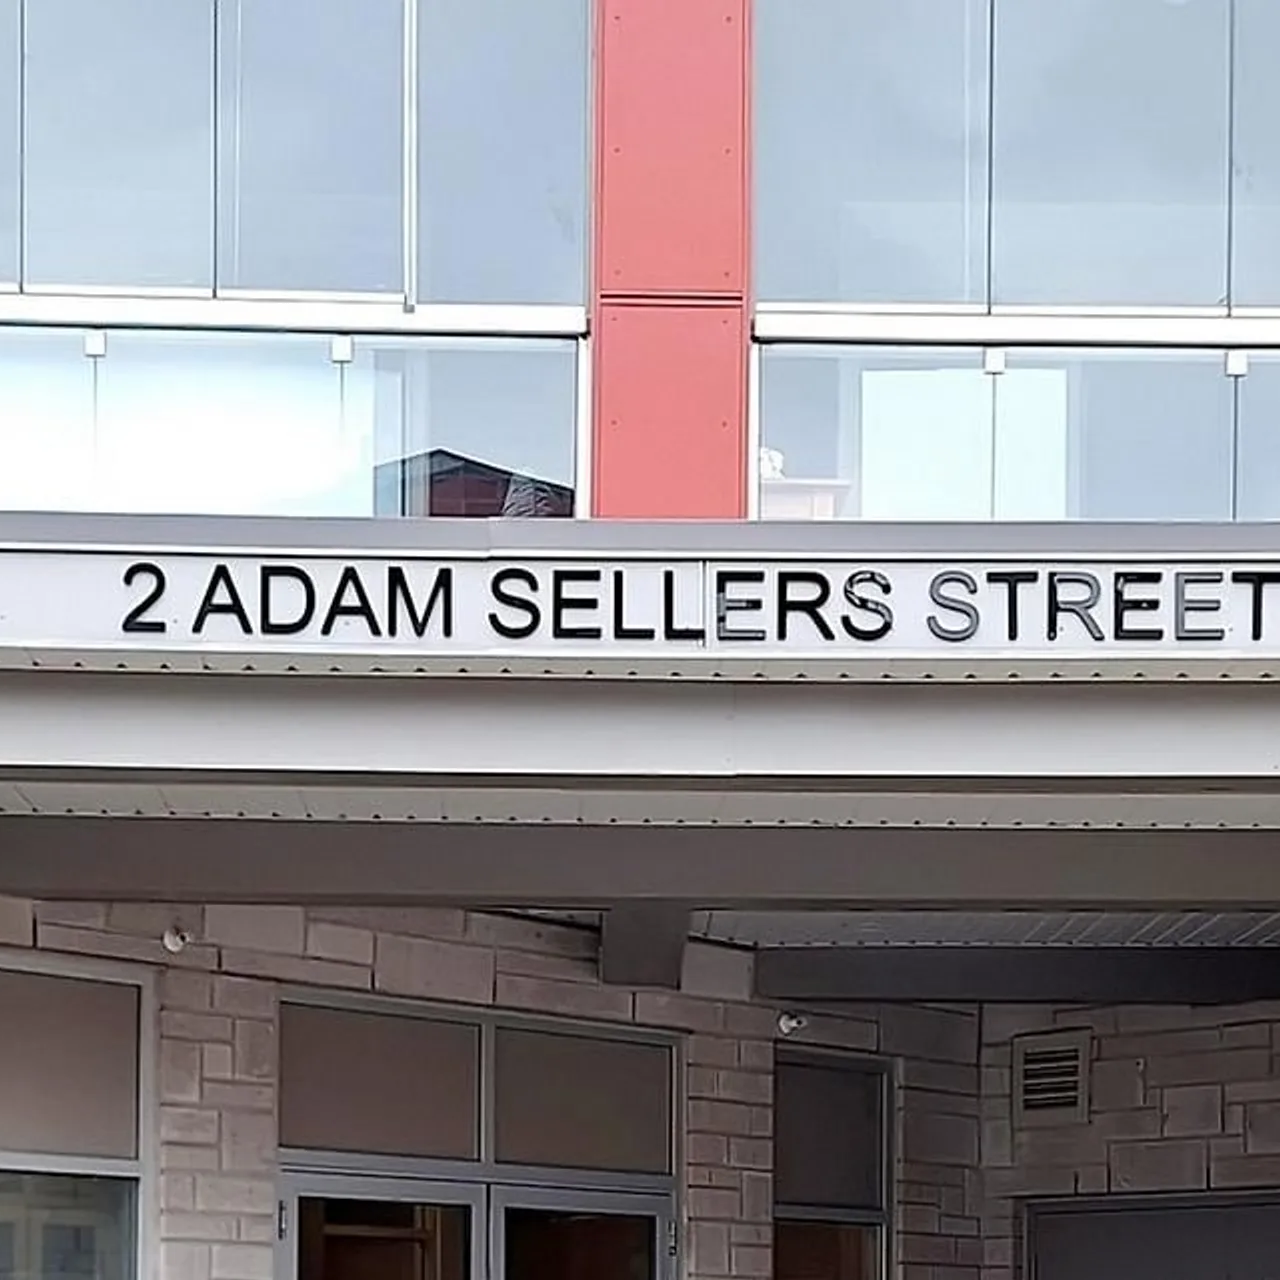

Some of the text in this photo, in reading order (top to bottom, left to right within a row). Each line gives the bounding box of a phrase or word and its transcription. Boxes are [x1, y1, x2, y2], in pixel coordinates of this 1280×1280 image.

[121, 562, 167, 634] 2
[191, 564, 453, 638] ADAM
[488, 567, 894, 642] SELLERS
